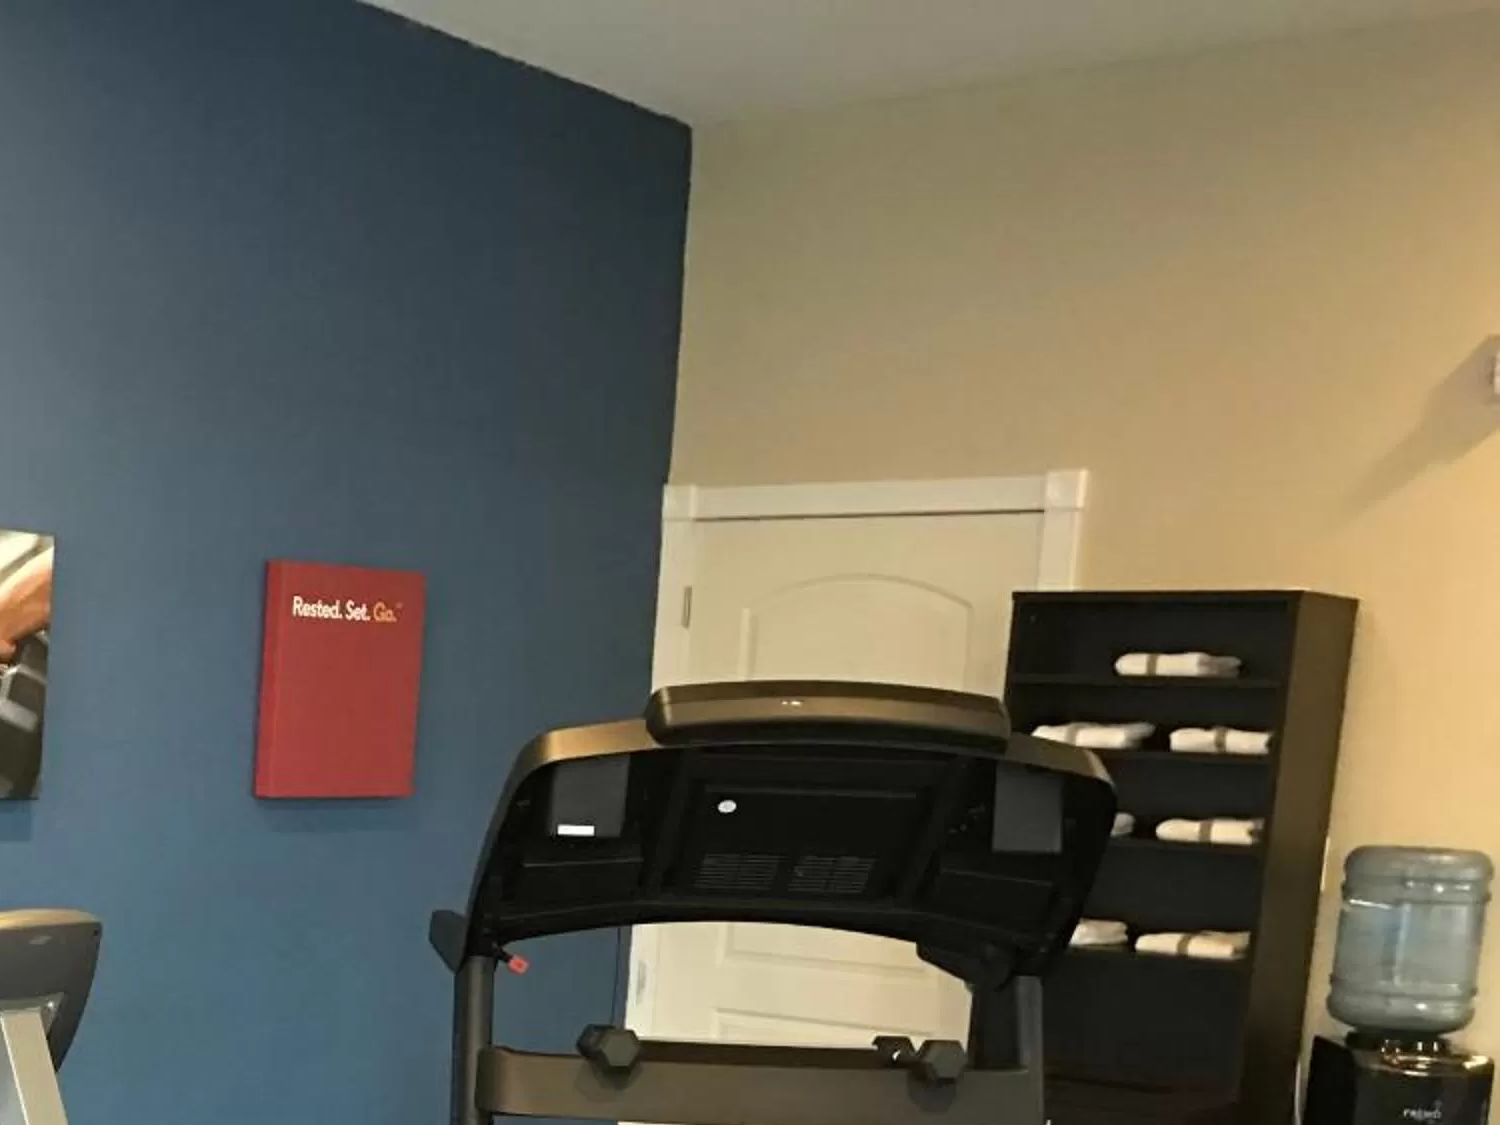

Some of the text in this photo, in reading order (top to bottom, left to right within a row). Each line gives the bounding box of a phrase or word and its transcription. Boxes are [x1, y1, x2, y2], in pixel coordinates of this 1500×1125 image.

[293, 595, 397, 622] Rested. Set. Go.
